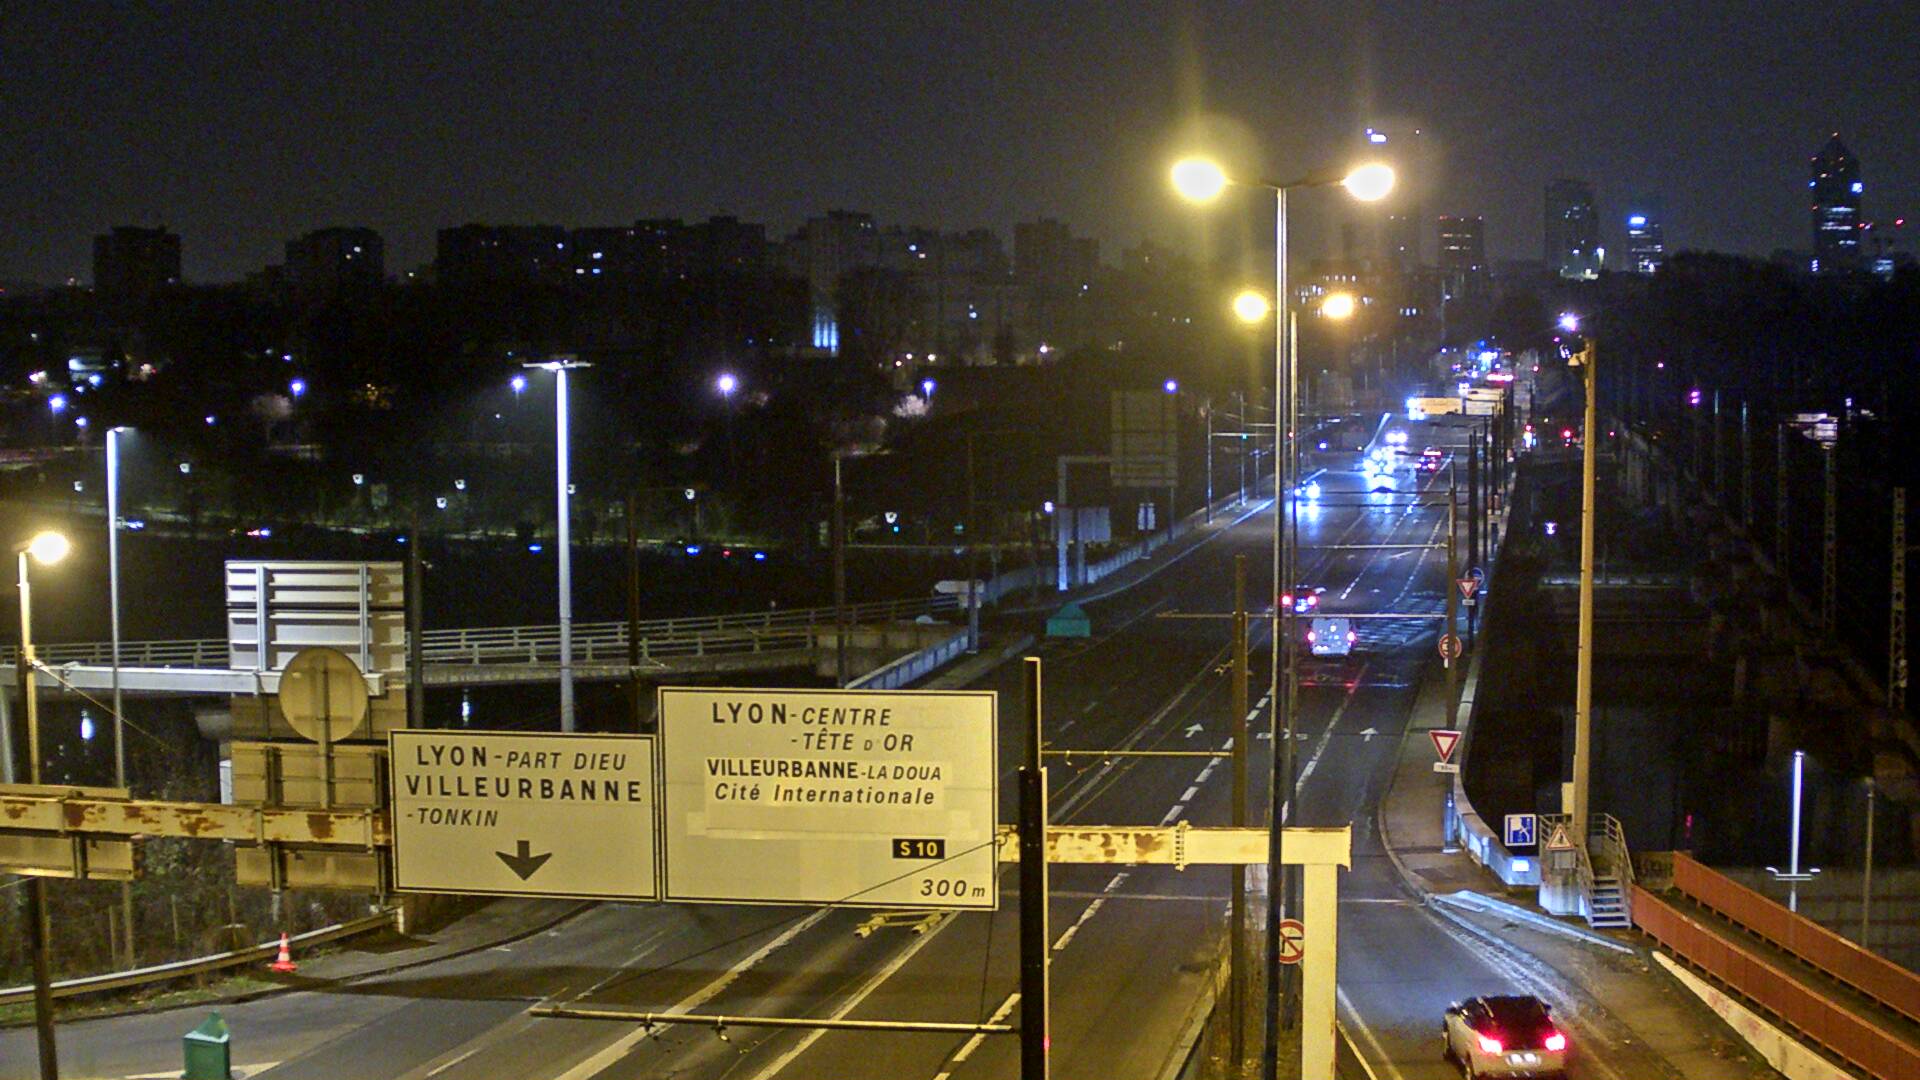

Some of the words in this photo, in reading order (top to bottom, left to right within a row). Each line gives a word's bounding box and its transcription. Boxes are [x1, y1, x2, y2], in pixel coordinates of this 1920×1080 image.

[574, 753, 627, 771] DIEU
[893, 766, 941, 780] DOUA
[406, 775, 641, 801] VILLEURBANNE
[715, 783, 760, 800] Cité
[774, 785, 934, 805] Internationale
[920, 879, 967, 897] 300
[972, 886, 985, 897] m
